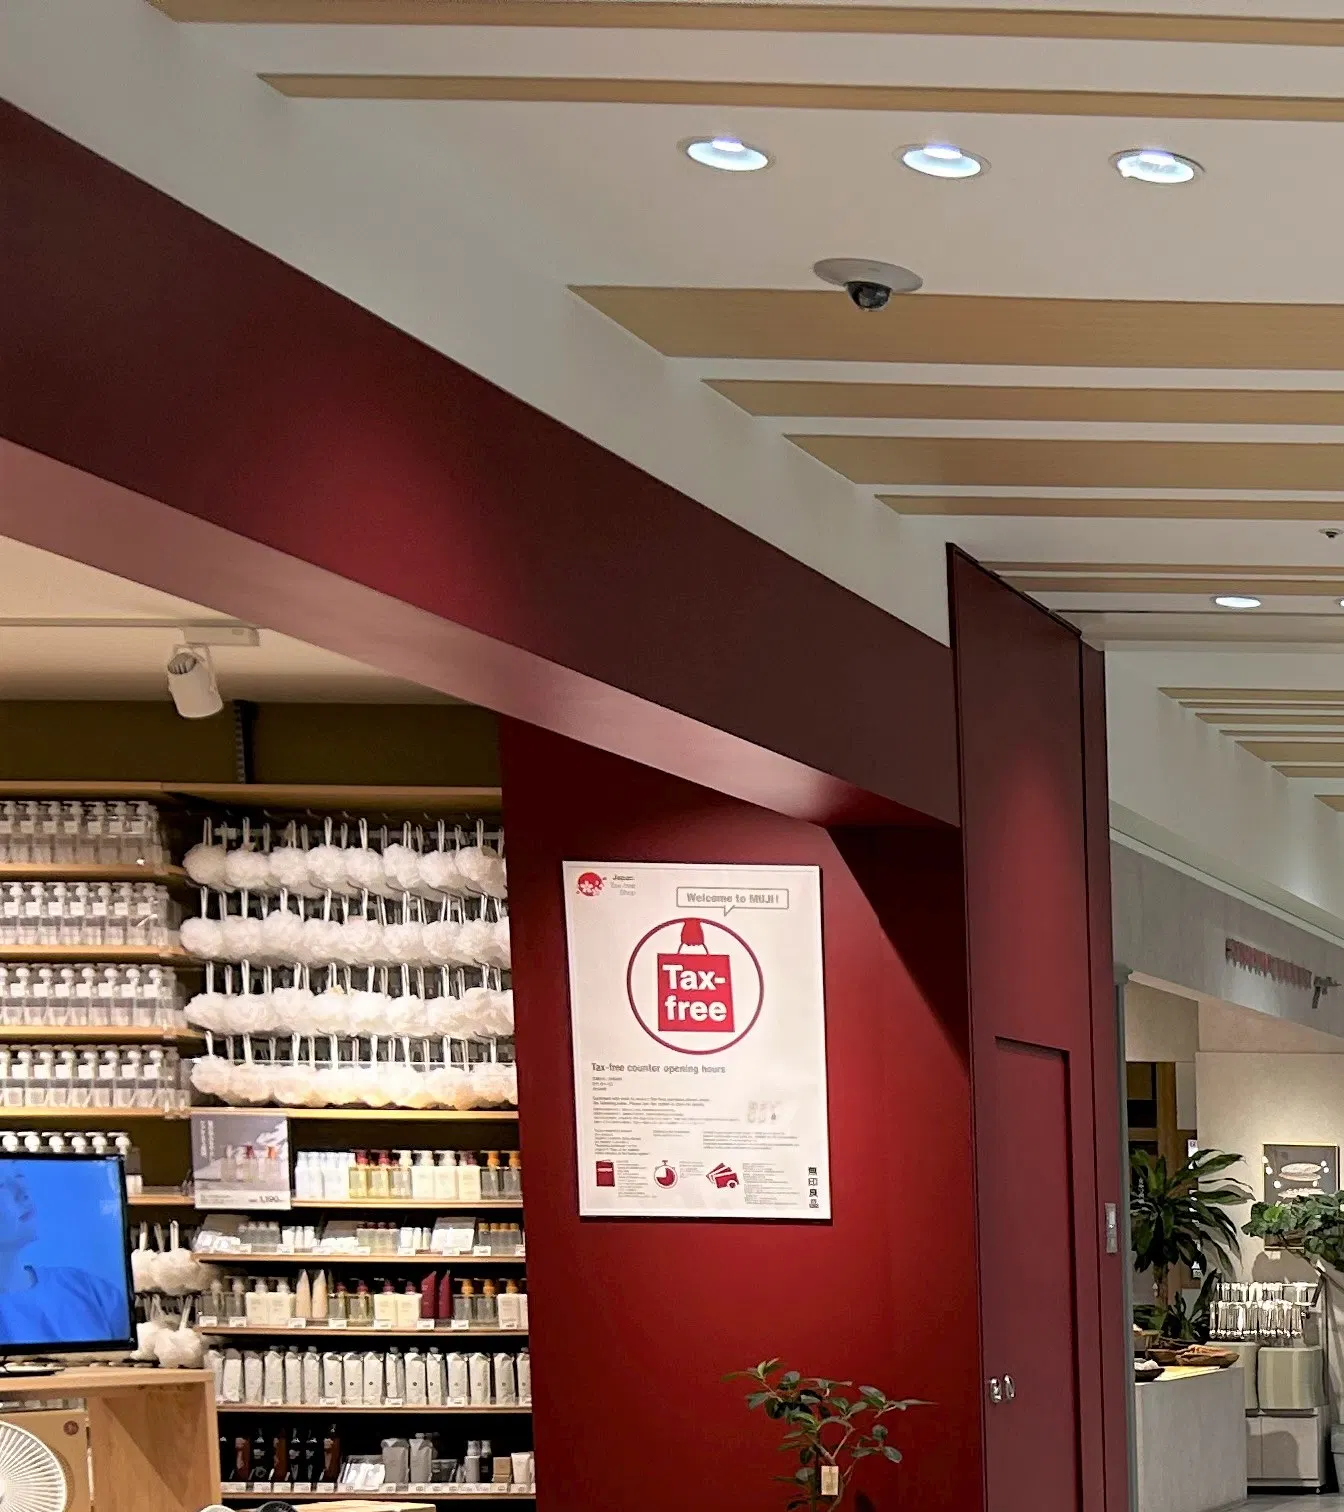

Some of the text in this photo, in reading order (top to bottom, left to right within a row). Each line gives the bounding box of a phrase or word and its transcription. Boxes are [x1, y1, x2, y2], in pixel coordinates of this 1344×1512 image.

[686, 892, 732, 903] Welcome
[735, 894, 746, 903] to
[662, 964, 726, 991] Tax-
[664, 995, 727, 1022] free
[592, 1063, 726, 1074] Tax-free counter opening hours
